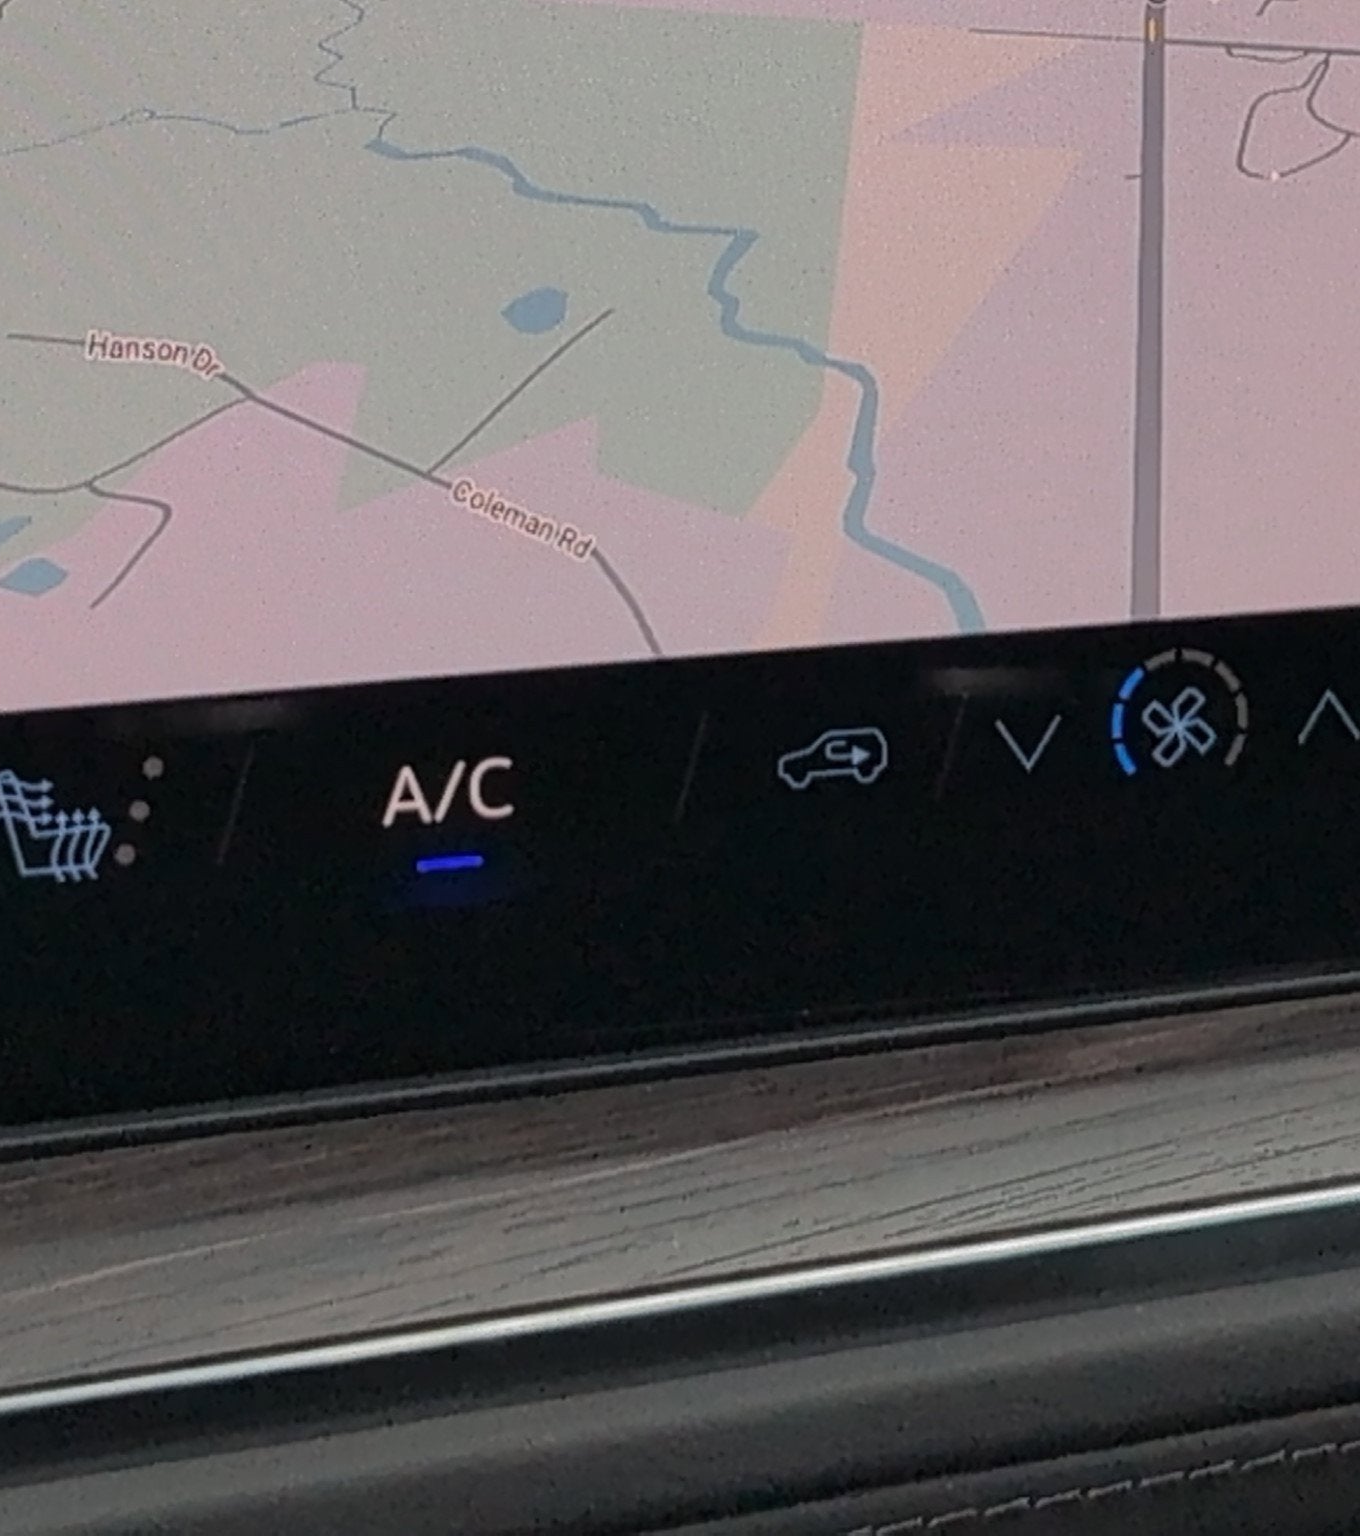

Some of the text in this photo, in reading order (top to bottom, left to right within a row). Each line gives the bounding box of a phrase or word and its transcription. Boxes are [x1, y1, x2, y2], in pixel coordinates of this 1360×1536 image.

[85, 331, 220, 377] Hanson Dr
[450, 480, 593, 560] Coleman Rd
[381, 757, 515, 829] A/C
